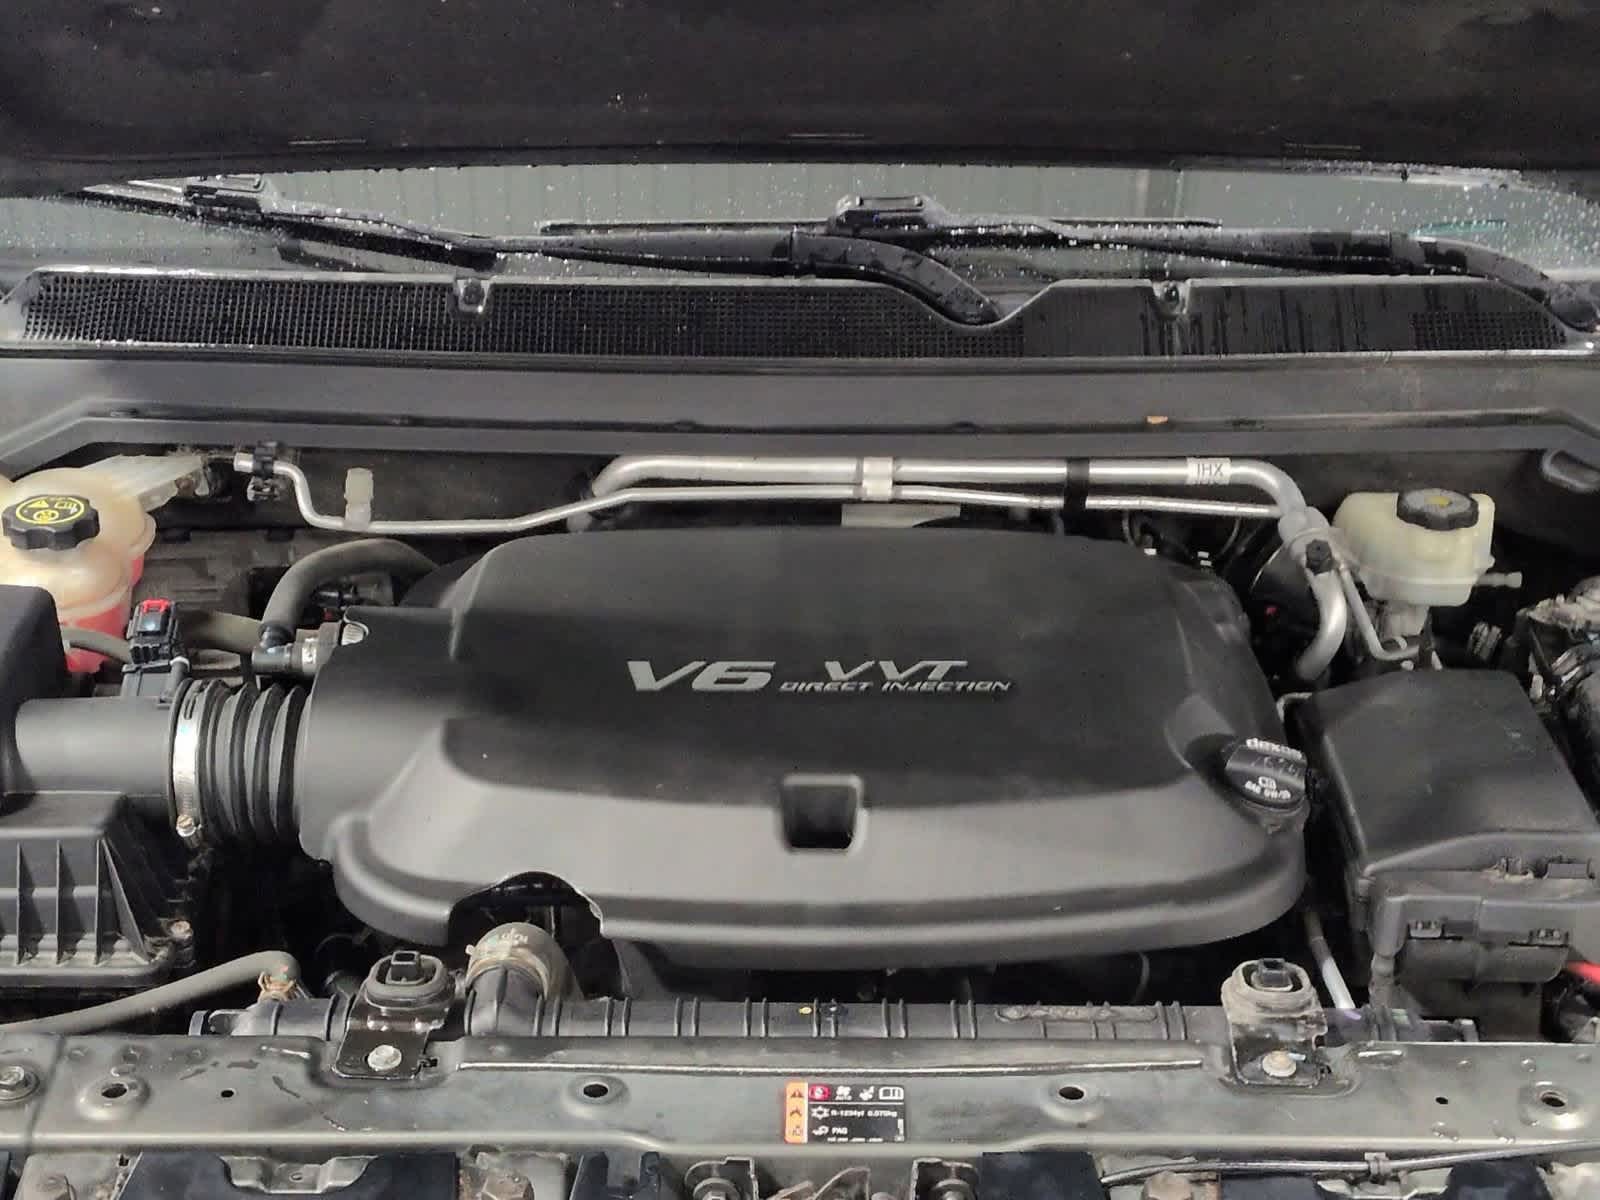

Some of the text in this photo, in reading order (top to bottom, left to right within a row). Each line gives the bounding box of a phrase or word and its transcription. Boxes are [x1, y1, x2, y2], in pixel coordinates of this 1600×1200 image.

[626, 660, 968, 691] V6 VVT
[779, 681, 1011, 692] DIRECT INJECTION
